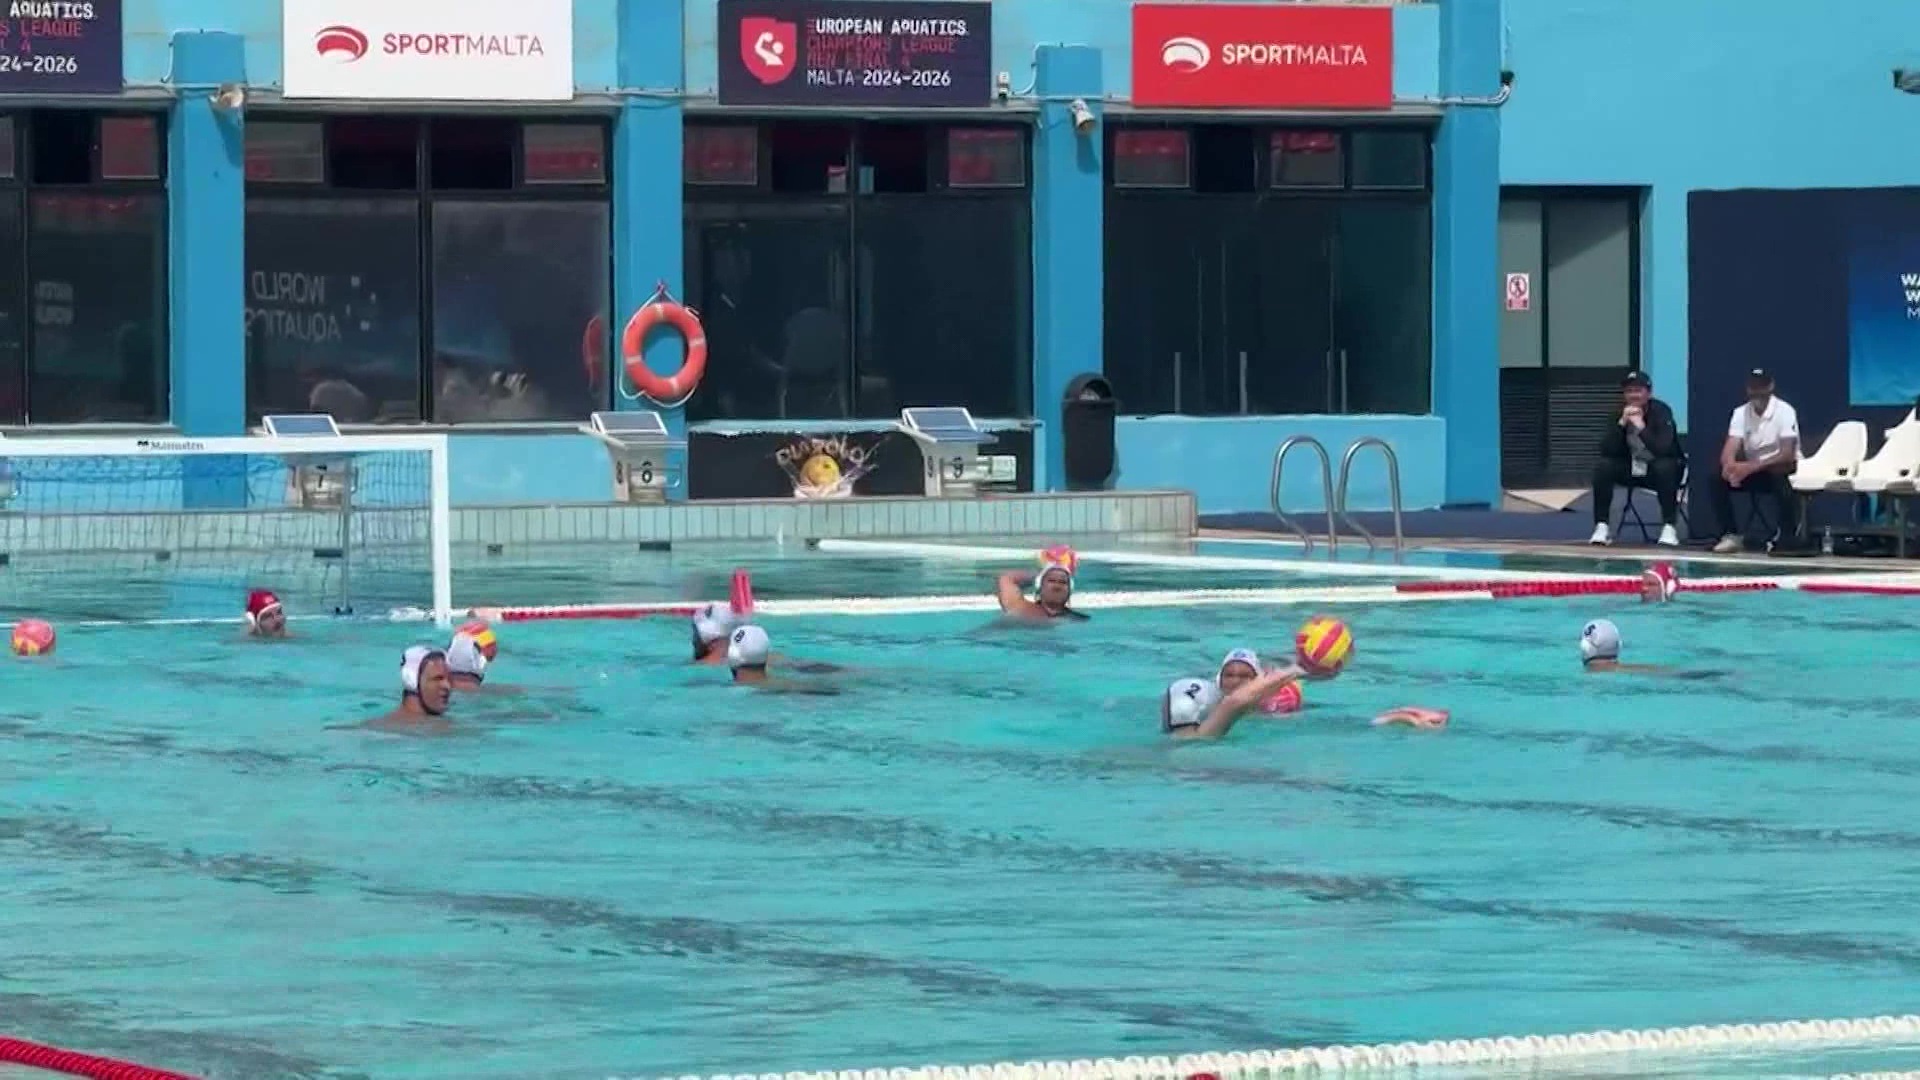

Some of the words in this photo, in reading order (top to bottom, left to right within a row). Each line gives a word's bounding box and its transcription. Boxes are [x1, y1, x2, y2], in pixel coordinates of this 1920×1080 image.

[9, 0, 95, 19] AQUATICS
[890, 19, 968, 37] AQUATICS
[382, 32, 545, 56] SPORTMALTA
[1221, 42, 1368, 66] SPORTMALTA
[807, 69, 855, 85] MALTA
[862, 70, 952, 87] 2024-2026
[1183, 682, 1202, 700] 2
